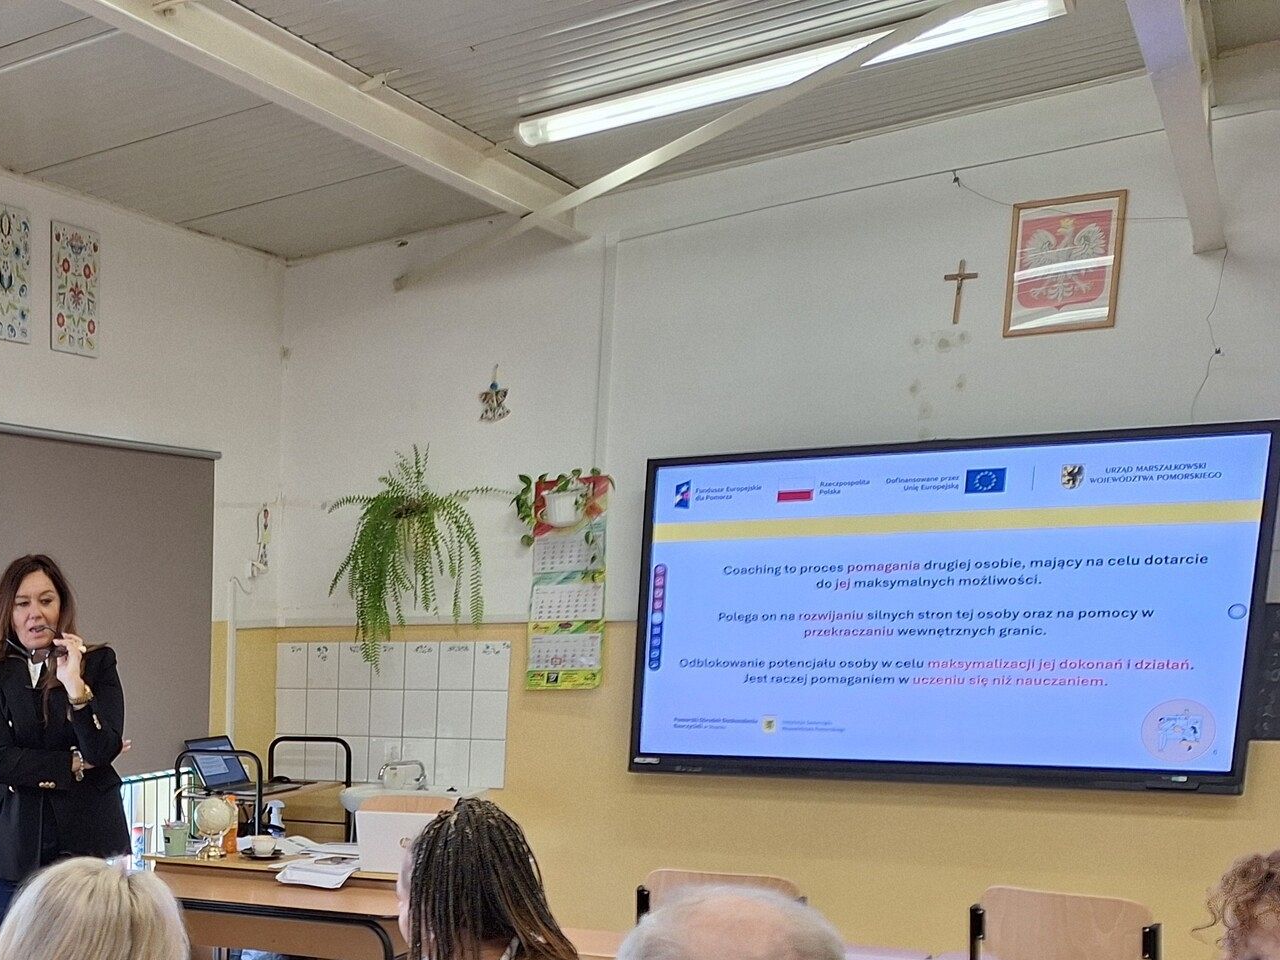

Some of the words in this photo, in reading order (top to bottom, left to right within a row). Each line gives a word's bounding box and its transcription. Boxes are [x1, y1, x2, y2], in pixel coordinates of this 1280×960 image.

[885, 475, 939, 485] Dofinansowane
[940, 475, 960, 484] przez
[1156, 470, 1223, 482] POMORSKIEGO
[726, 484, 762, 494] Europejskie
[819, 488, 841, 496] Polska
[723, 563, 781, 577] Coaching
[784, 564, 796, 575] to
[800, 562, 844, 574] proces
[847, 560, 920, 574] pomagania
[924, 559, 971, 571] drugiej
[974, 557, 1026, 570] osobie,
[1030, 556, 1083, 570] mający
[1086, 557, 1103, 567] na
[1107, 555, 1140, 566] celu
[1144, 553, 1208, 565] dotarcie
[816, 578, 832, 590] do
[834, 577, 850, 591] jej
[854, 576, 955, 590] maksymalnych
[958, 573, 1042, 587] możliwości.
[718, 611, 758, 625] Polega
[761, 612, 777, 622] on
[780, 611, 795, 622] na
[798, 609, 863, 623] rozwijaniu
[867, 609, 914, 622] silnych
[918, 609, 953, 621] stron
[956, 609, 974, 622] tej
[977, 608, 1020, 621] osoby
[1023, 609, 1053, 620] oraz
[1056, 609, 1074, 620] na
[1077, 608, 1138, 621] pomocy
[1141, 608, 1155, 619] w
[803, 626, 894, 639] przekraczaniu
[897, 625, 996, 638] wewnętrznych
[999, 625, 1047, 638] granic.
[679, 657, 765, 669] Odblokowanie
[768, 657, 836, 671] potencjału
[839, 657, 878, 671] osoby
[881, 659, 893, 669] w
[895, 658, 924, 669] celu
[927, 658, 1035, 671] maksymalizacji
[1038, 658, 1056, 671] jej
[1059, 657, 1123, 670] dokonań
[1126, 657, 1132, 670] i
[1134, 657, 1195, 671] działań.
[743, 673, 767, 685] Jest
[770, 673, 808, 687] raczej
[810, 673, 895, 687] pomaganiem
[898, 675, 909, 685] w
[912, 674, 965, 686] uczeniu
[969, 674, 989, 688] się
[992, 673, 1012, 687] niż
[1015, 675, 1109, 687] nauczaniem.
